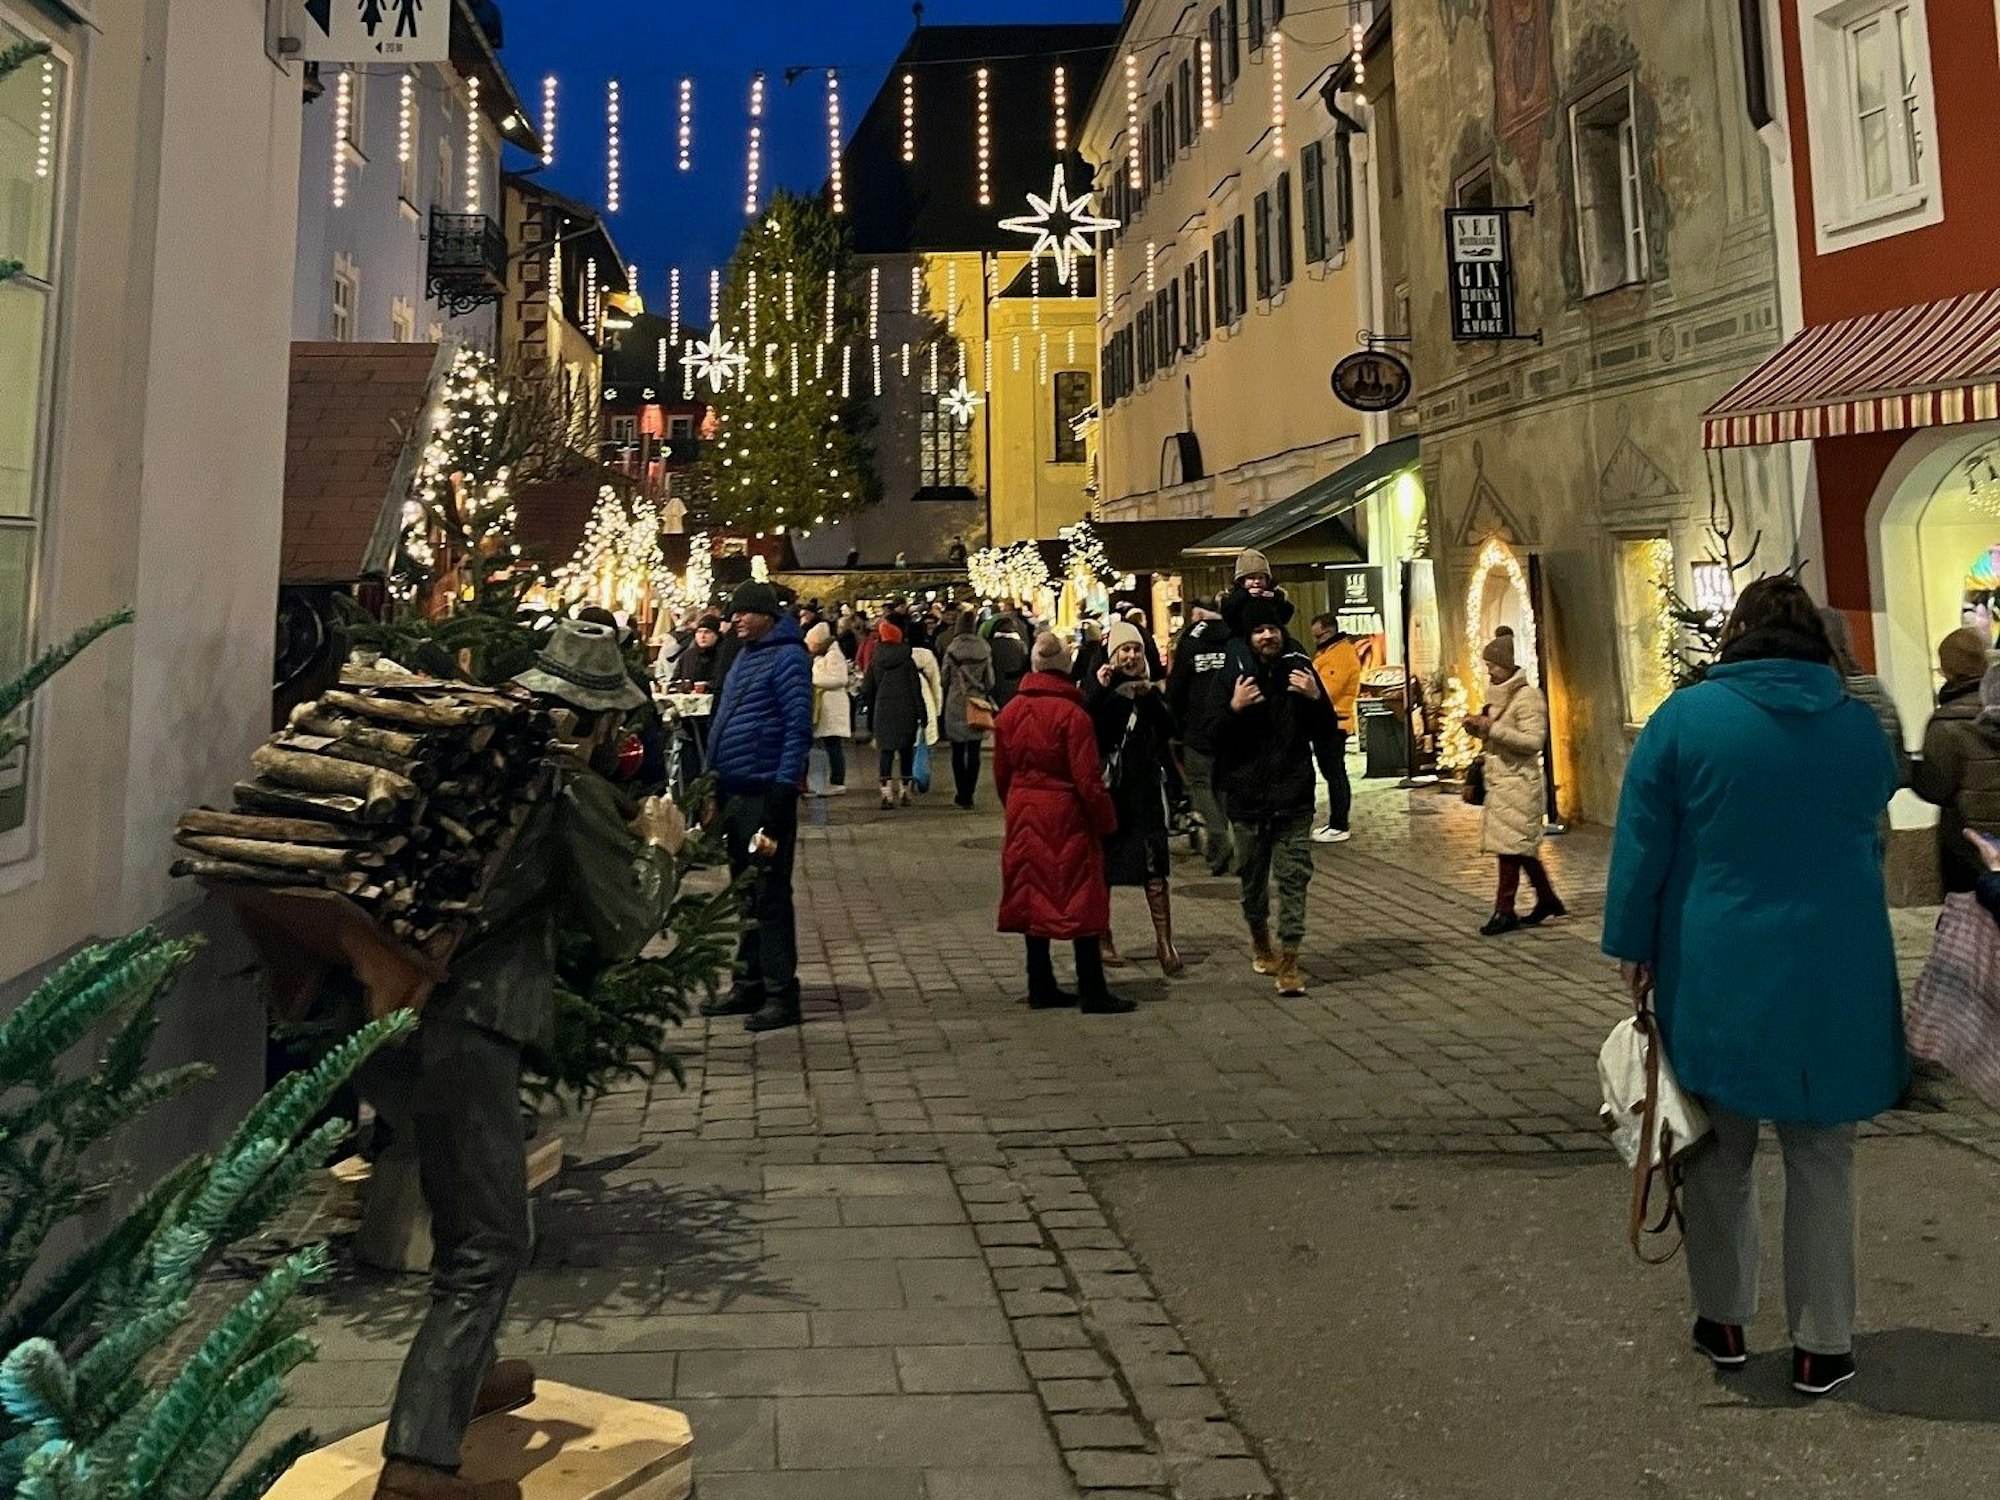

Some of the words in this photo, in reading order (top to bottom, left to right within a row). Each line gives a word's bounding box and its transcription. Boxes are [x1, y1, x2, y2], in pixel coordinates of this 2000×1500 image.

[1457, 218, 1497, 236] SEE
[1458, 262, 1500, 288] GIN
[1462, 301, 1502, 320] RUM
